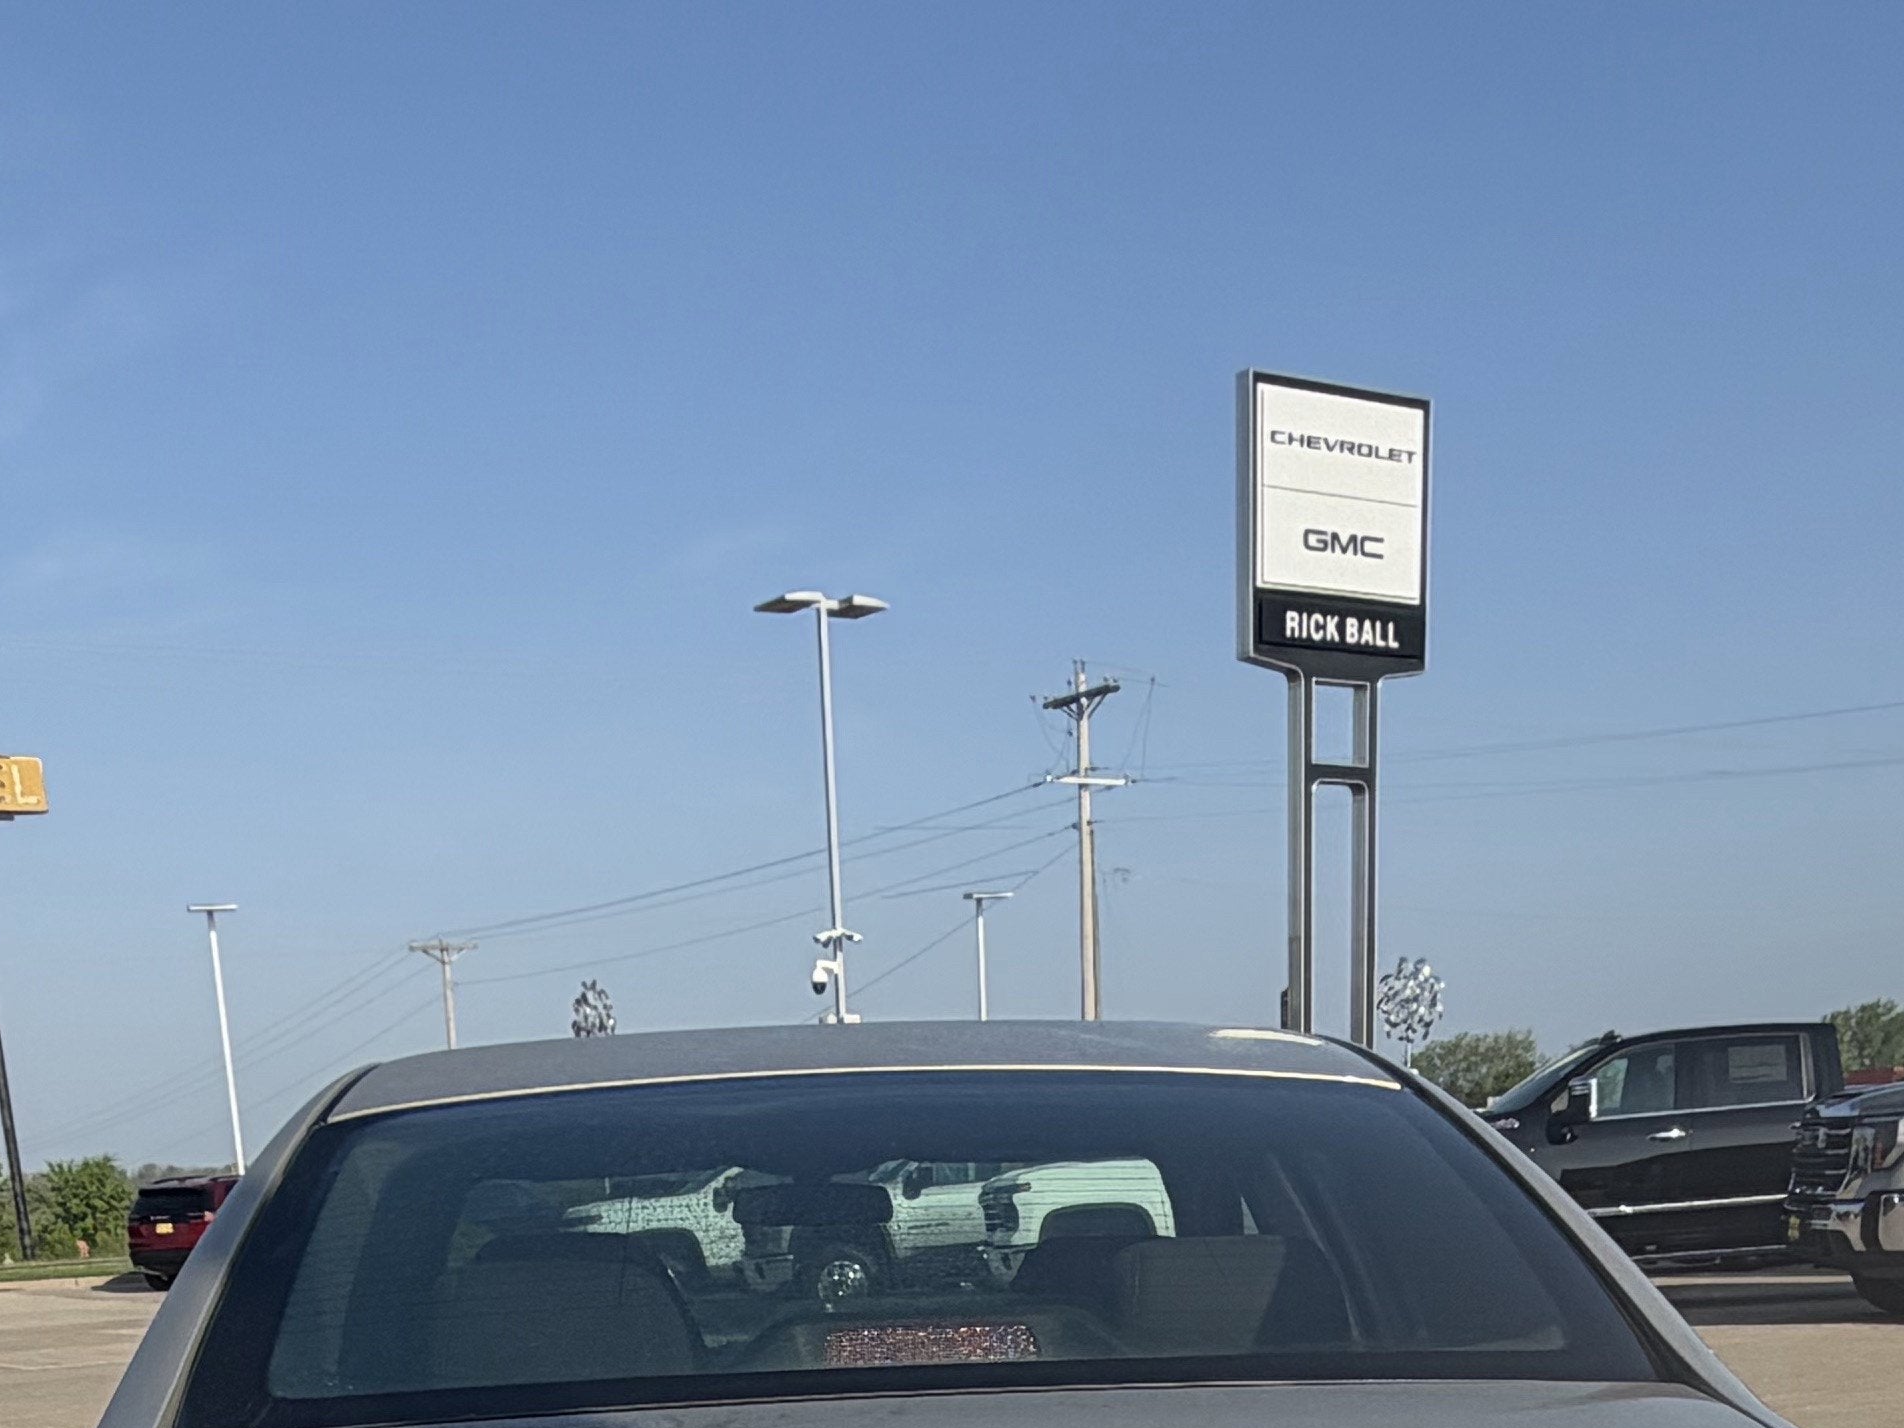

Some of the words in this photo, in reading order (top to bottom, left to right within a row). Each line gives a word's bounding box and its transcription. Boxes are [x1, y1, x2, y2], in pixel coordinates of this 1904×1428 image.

[1270, 430, 1418, 464] CHEVROLET
[1303, 528, 1384, 560] GMC
[1285, 610, 1340, 643] RICK
[1346, 616, 1400, 649] BALL
